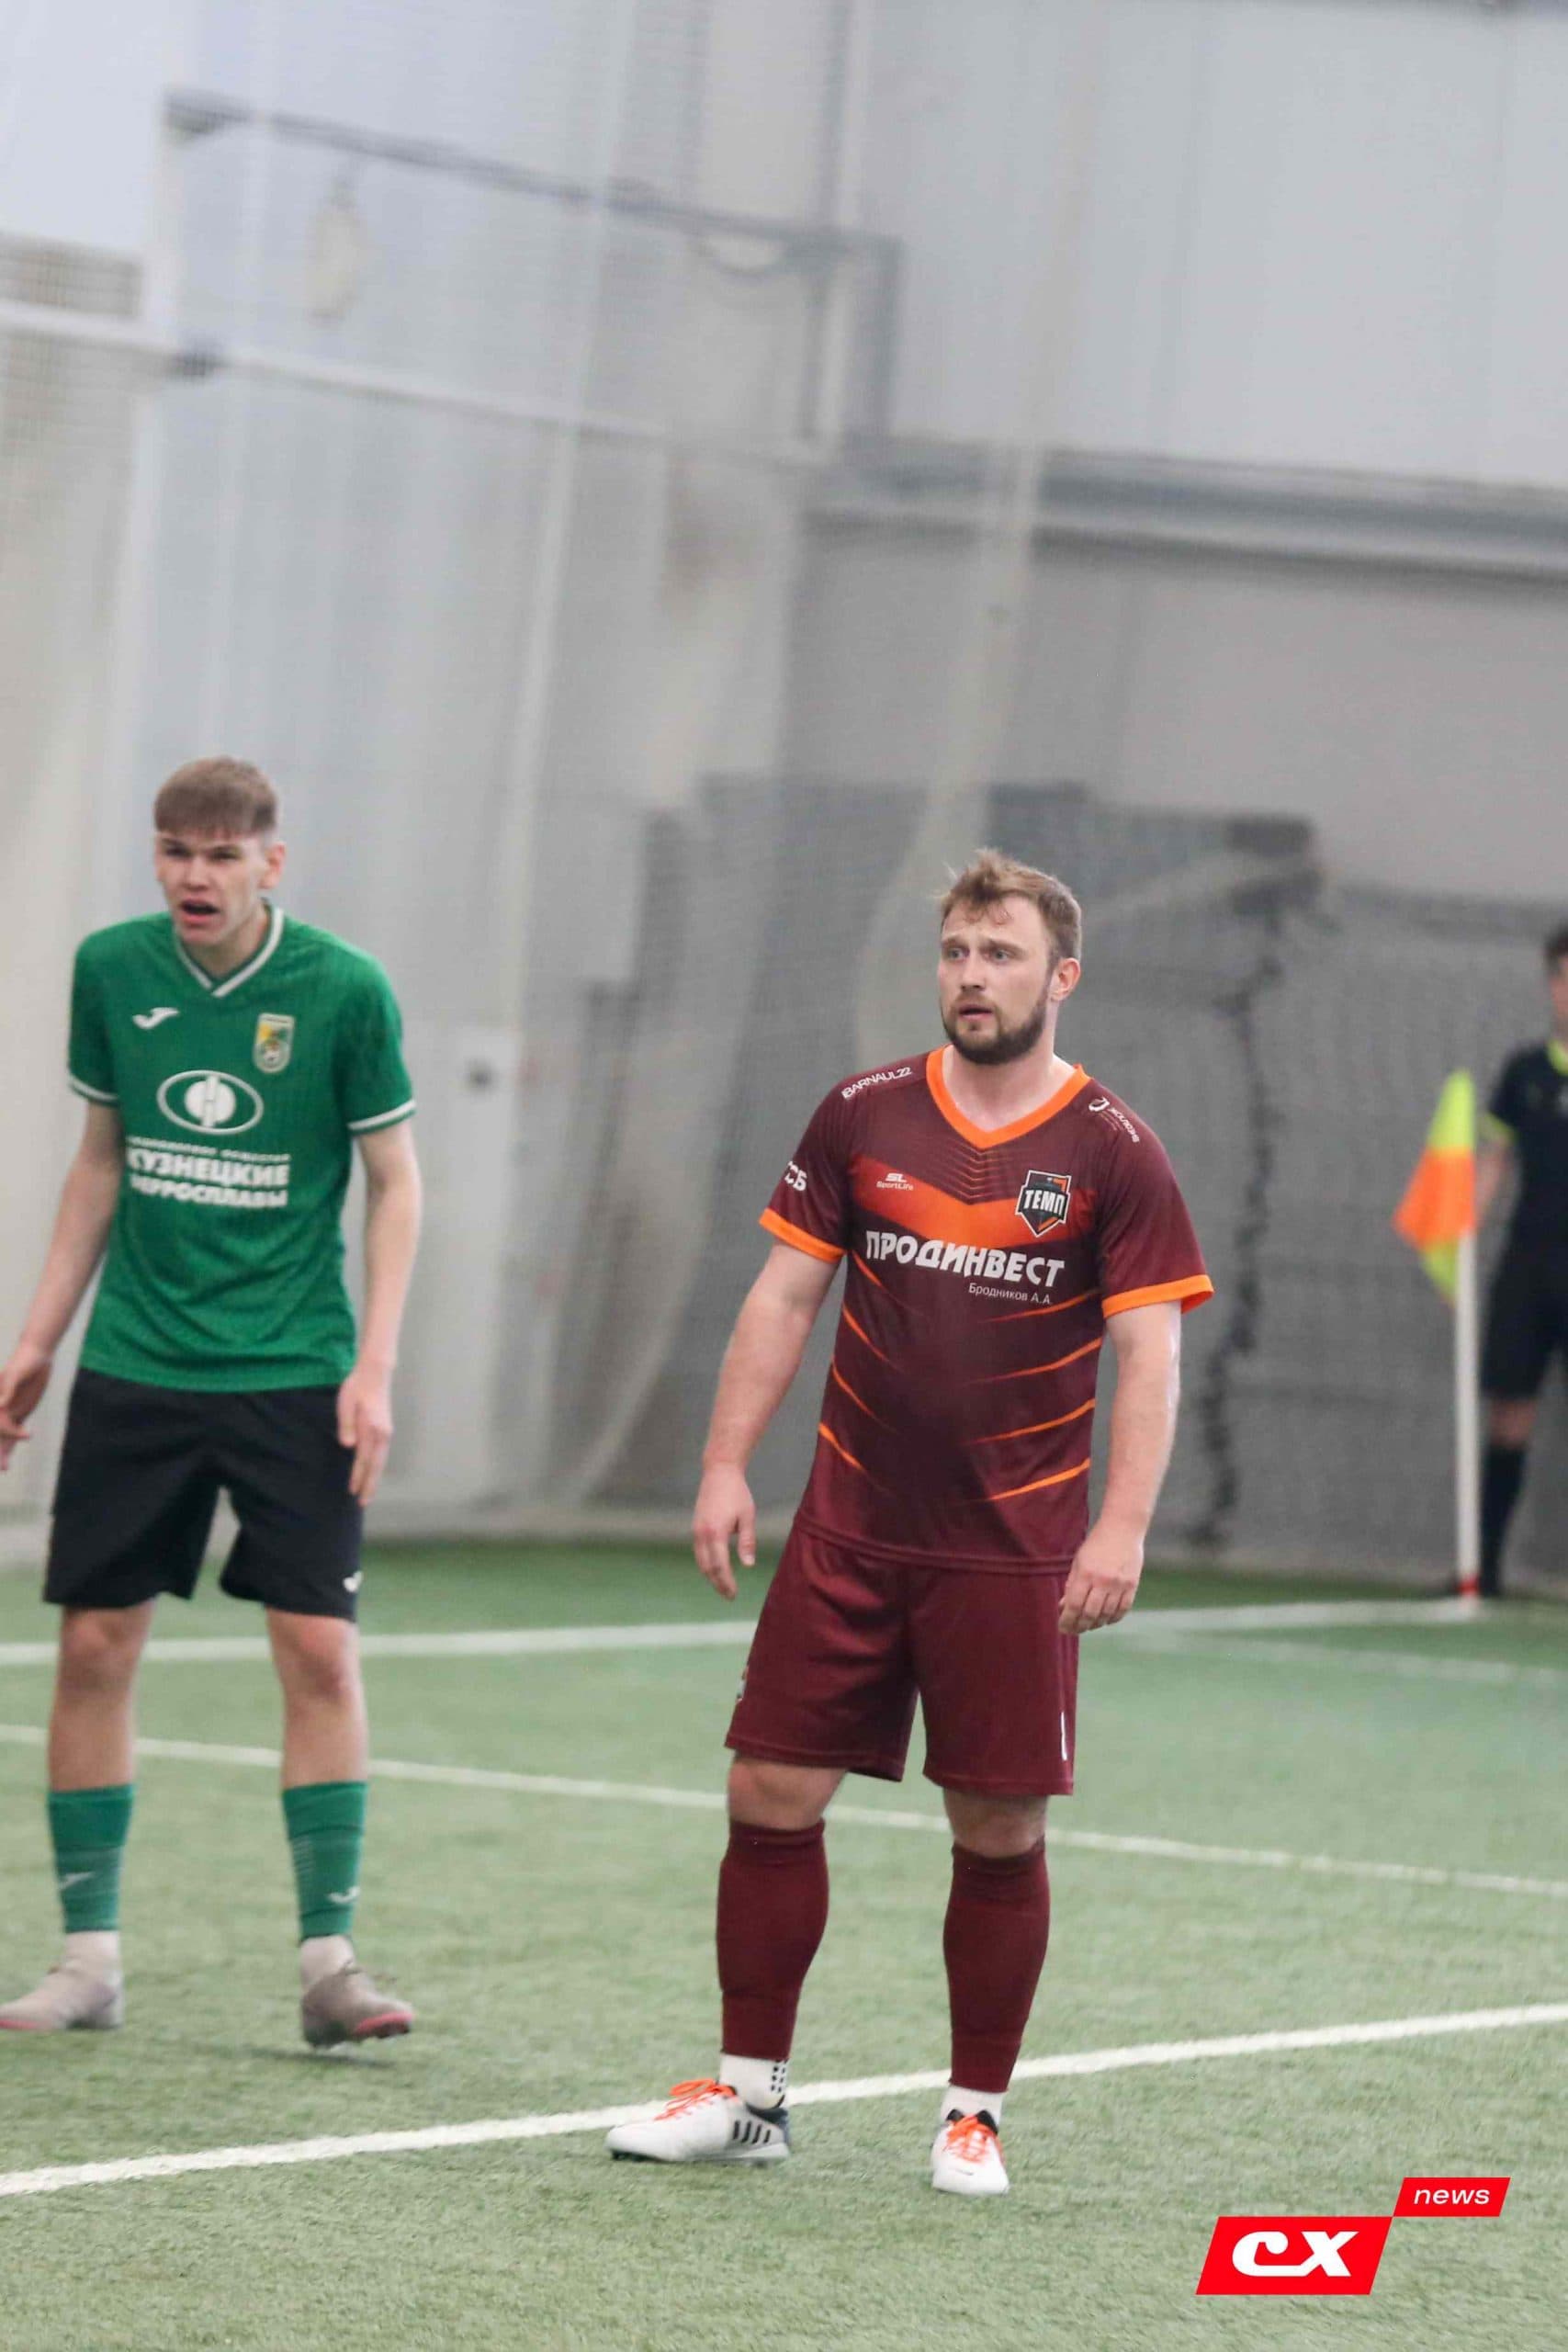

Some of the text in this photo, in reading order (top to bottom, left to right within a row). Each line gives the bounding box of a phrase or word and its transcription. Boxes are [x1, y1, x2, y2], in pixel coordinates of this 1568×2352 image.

[841, 1067, 912, 1099] BARNAUL22
[784, 1160, 807, 1192] СБ
[1023, 1189, 1066, 1216] ТЕМП
[865, 1230, 1066, 1287] ПРОДИНВЕСТ
[968, 1282, 1029, 1301] Бродников
